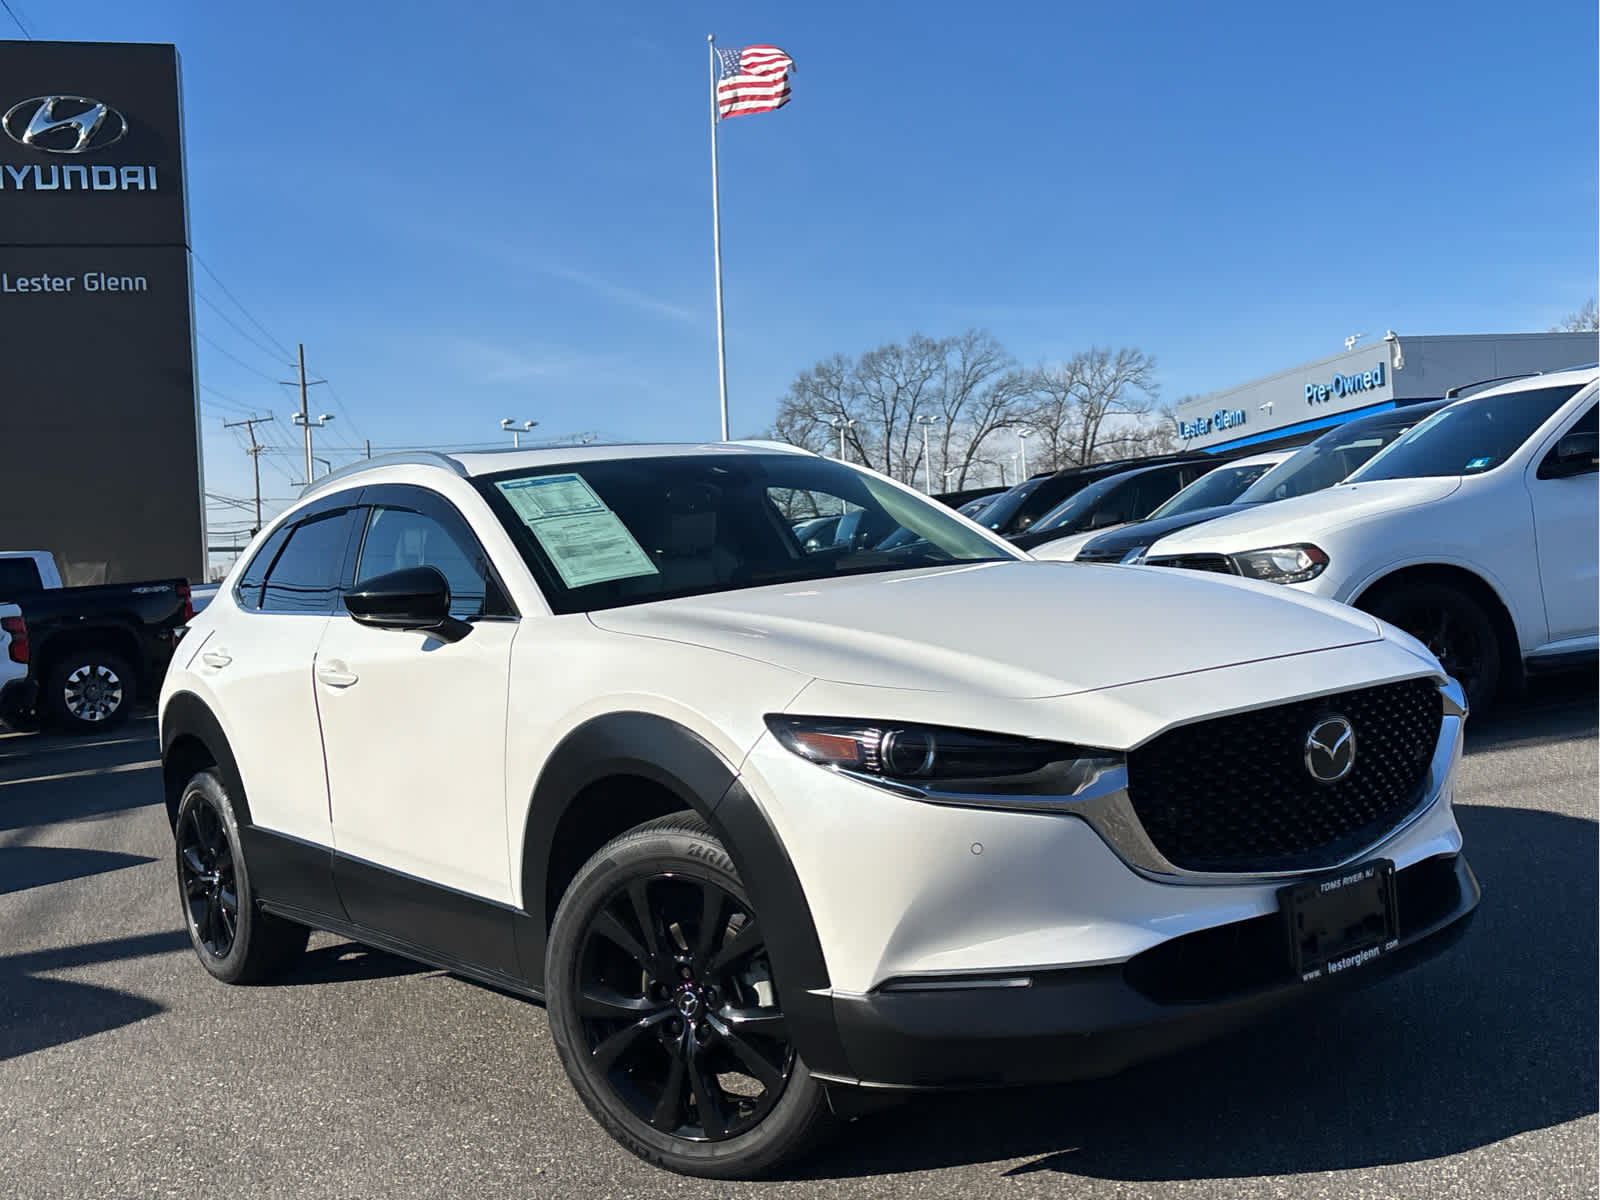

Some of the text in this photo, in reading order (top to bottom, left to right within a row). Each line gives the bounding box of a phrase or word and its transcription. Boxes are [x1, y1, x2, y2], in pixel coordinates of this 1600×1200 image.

[0, 164, 158, 191] YUNDAI
[2, 272, 148, 293] Lester Glenn
[1304, 362, 1386, 406] Pre-Owned
[1178, 408, 1246, 439] Lester Glenn
